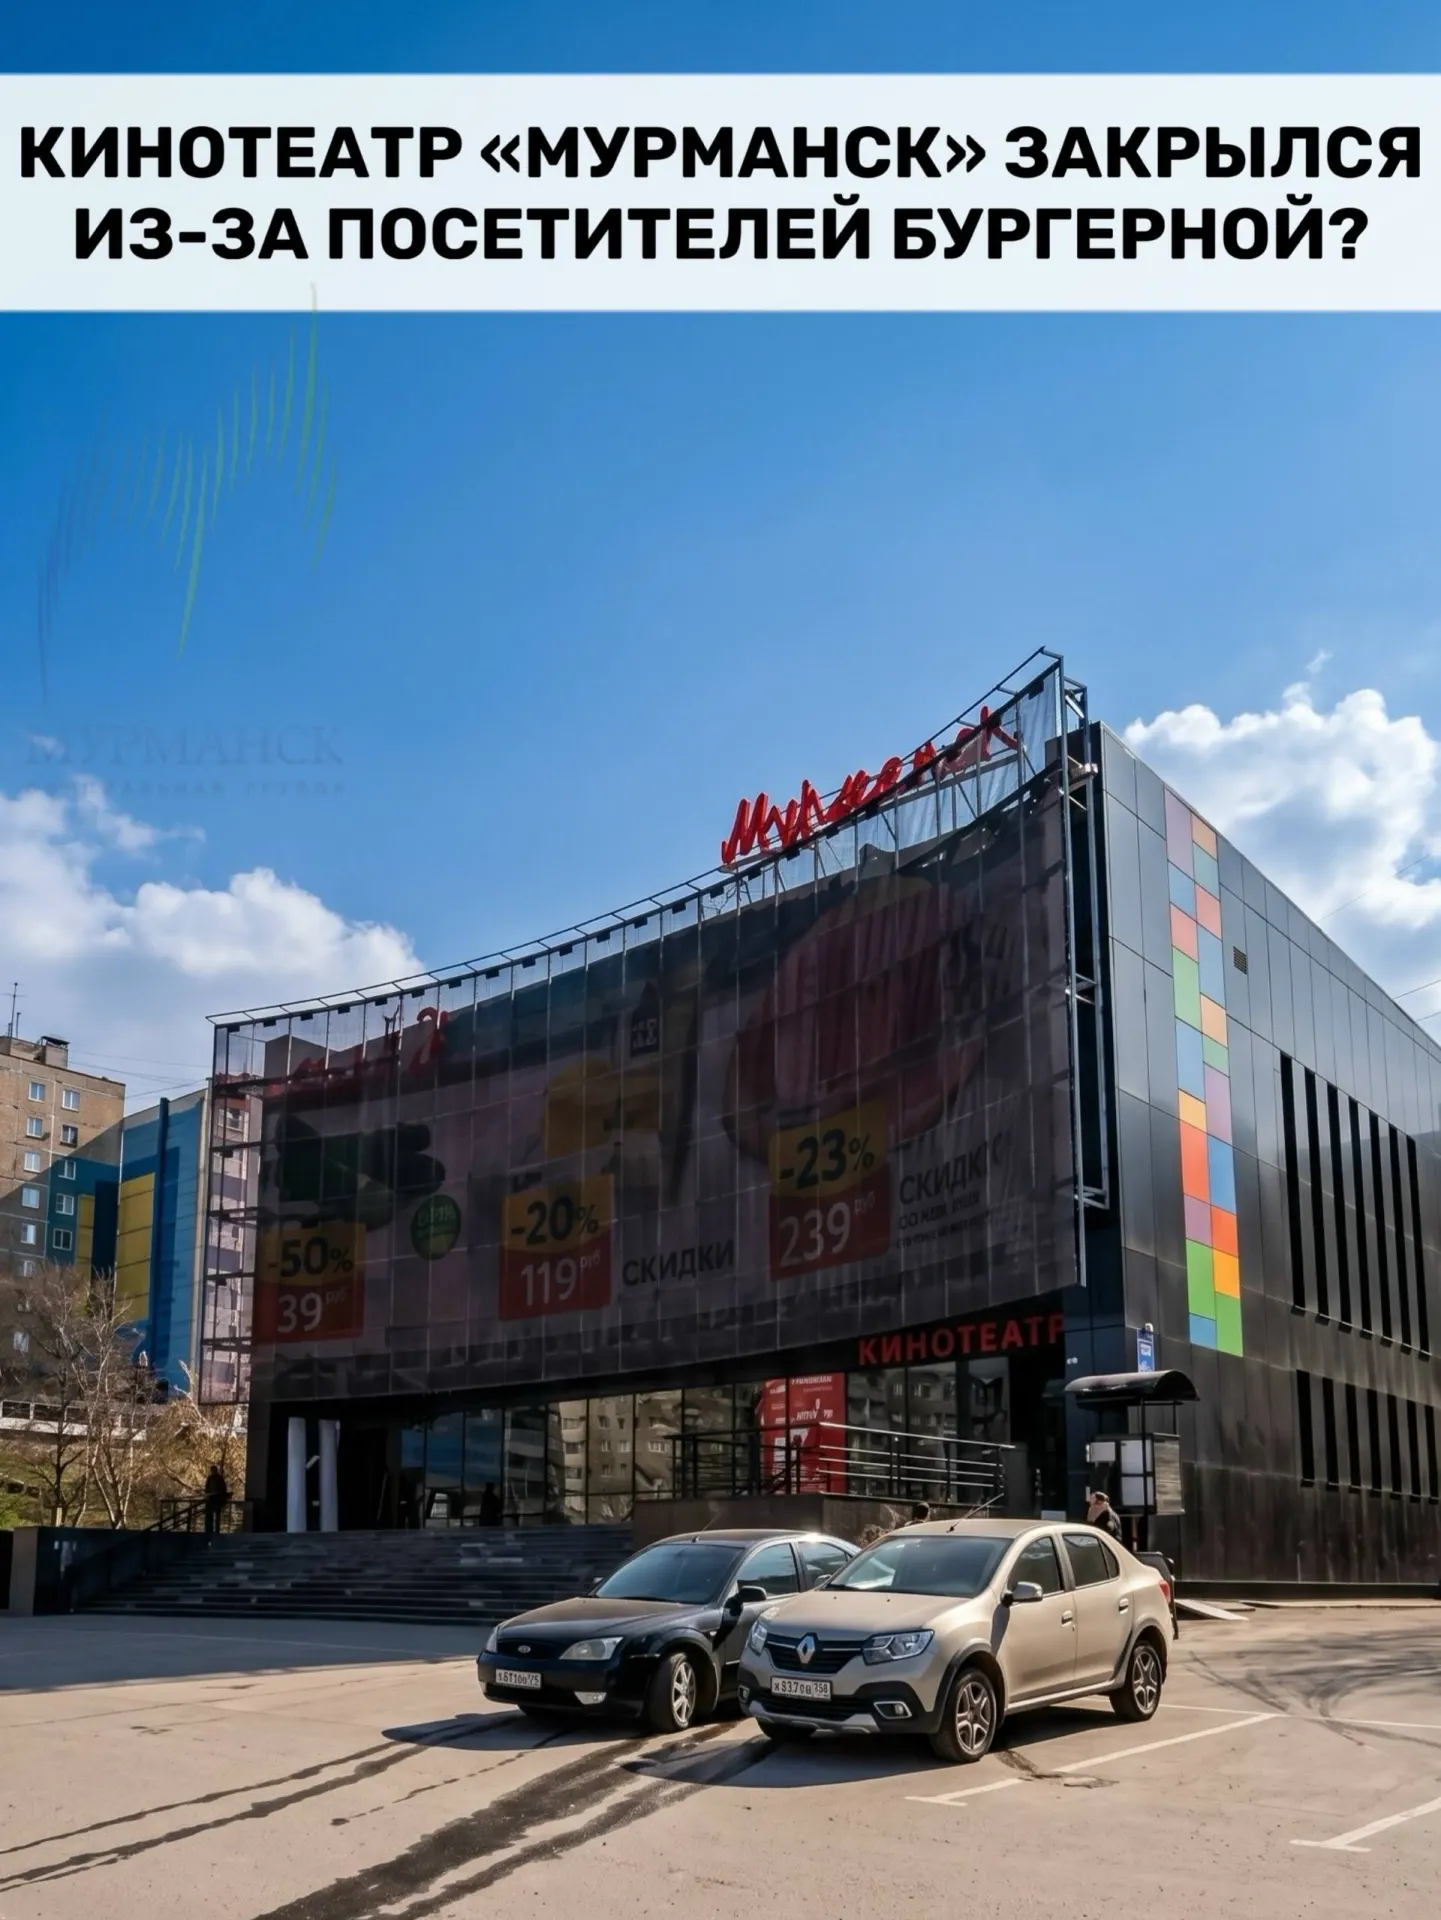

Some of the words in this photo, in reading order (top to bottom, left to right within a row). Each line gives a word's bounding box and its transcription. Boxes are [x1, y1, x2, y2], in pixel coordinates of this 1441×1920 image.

[779, 1128, 875, 1191] -23%
[510, 1195, 599, 1247] -20%
[778, 1201, 851, 1267] 239
[266, 1236, 354, 1278] -50%
[520, 1257, 578, 1307] 119
[622, 1239, 734, 1287] СКИДКИ
[276, 1291, 323, 1334] 39
[858, 1312, 1064, 1366] КИНОТЕАТР
